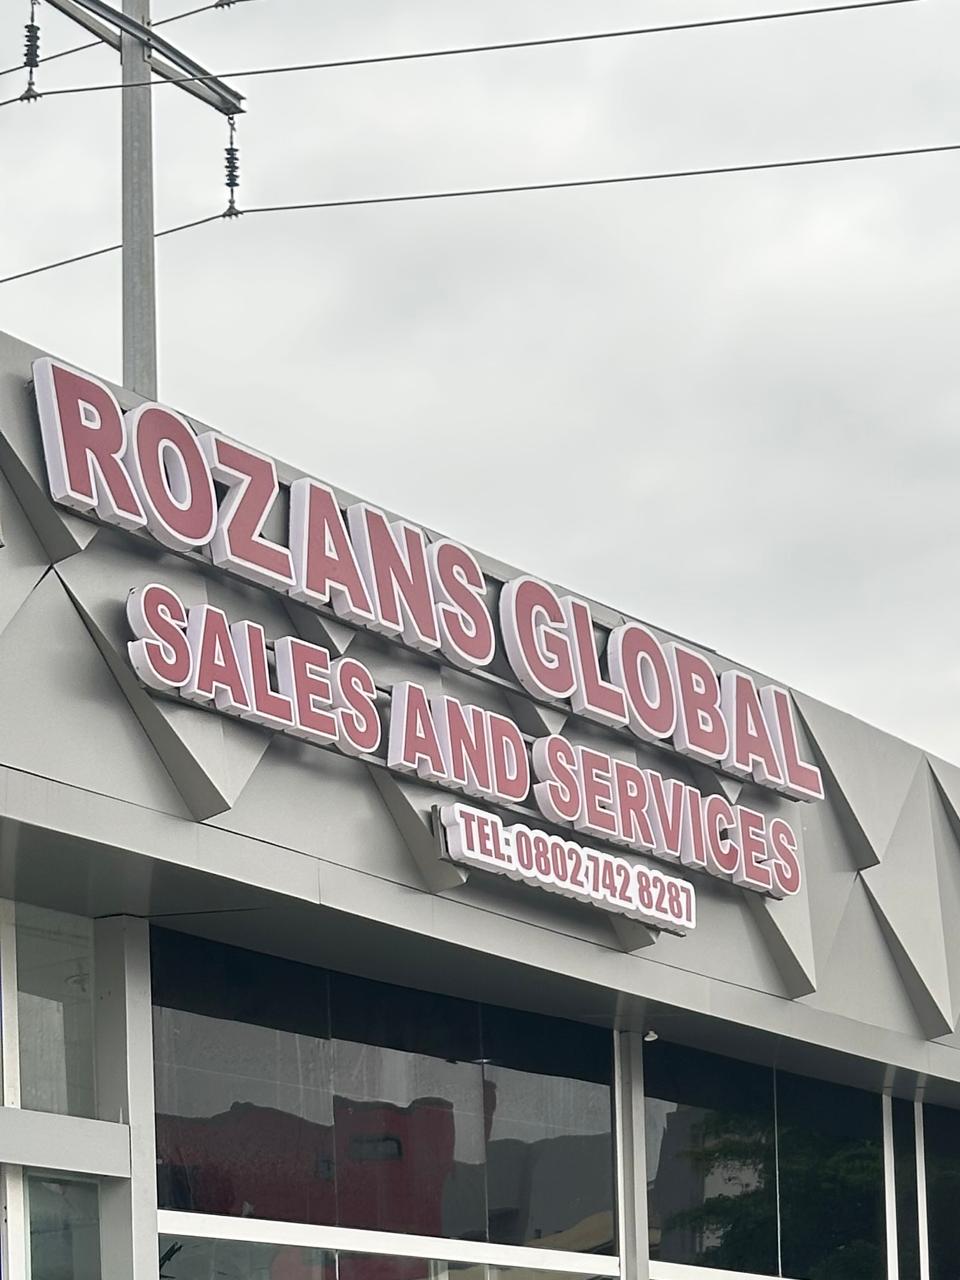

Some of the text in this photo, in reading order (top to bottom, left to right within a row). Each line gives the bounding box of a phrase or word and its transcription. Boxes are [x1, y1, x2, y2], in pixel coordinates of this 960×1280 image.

[36, 358, 824, 802] ROZANS GLOBAL
[127, 583, 801, 899] SALES AND SERVICES
[459, 809, 693, 922] TEL: 0802 742 8287
